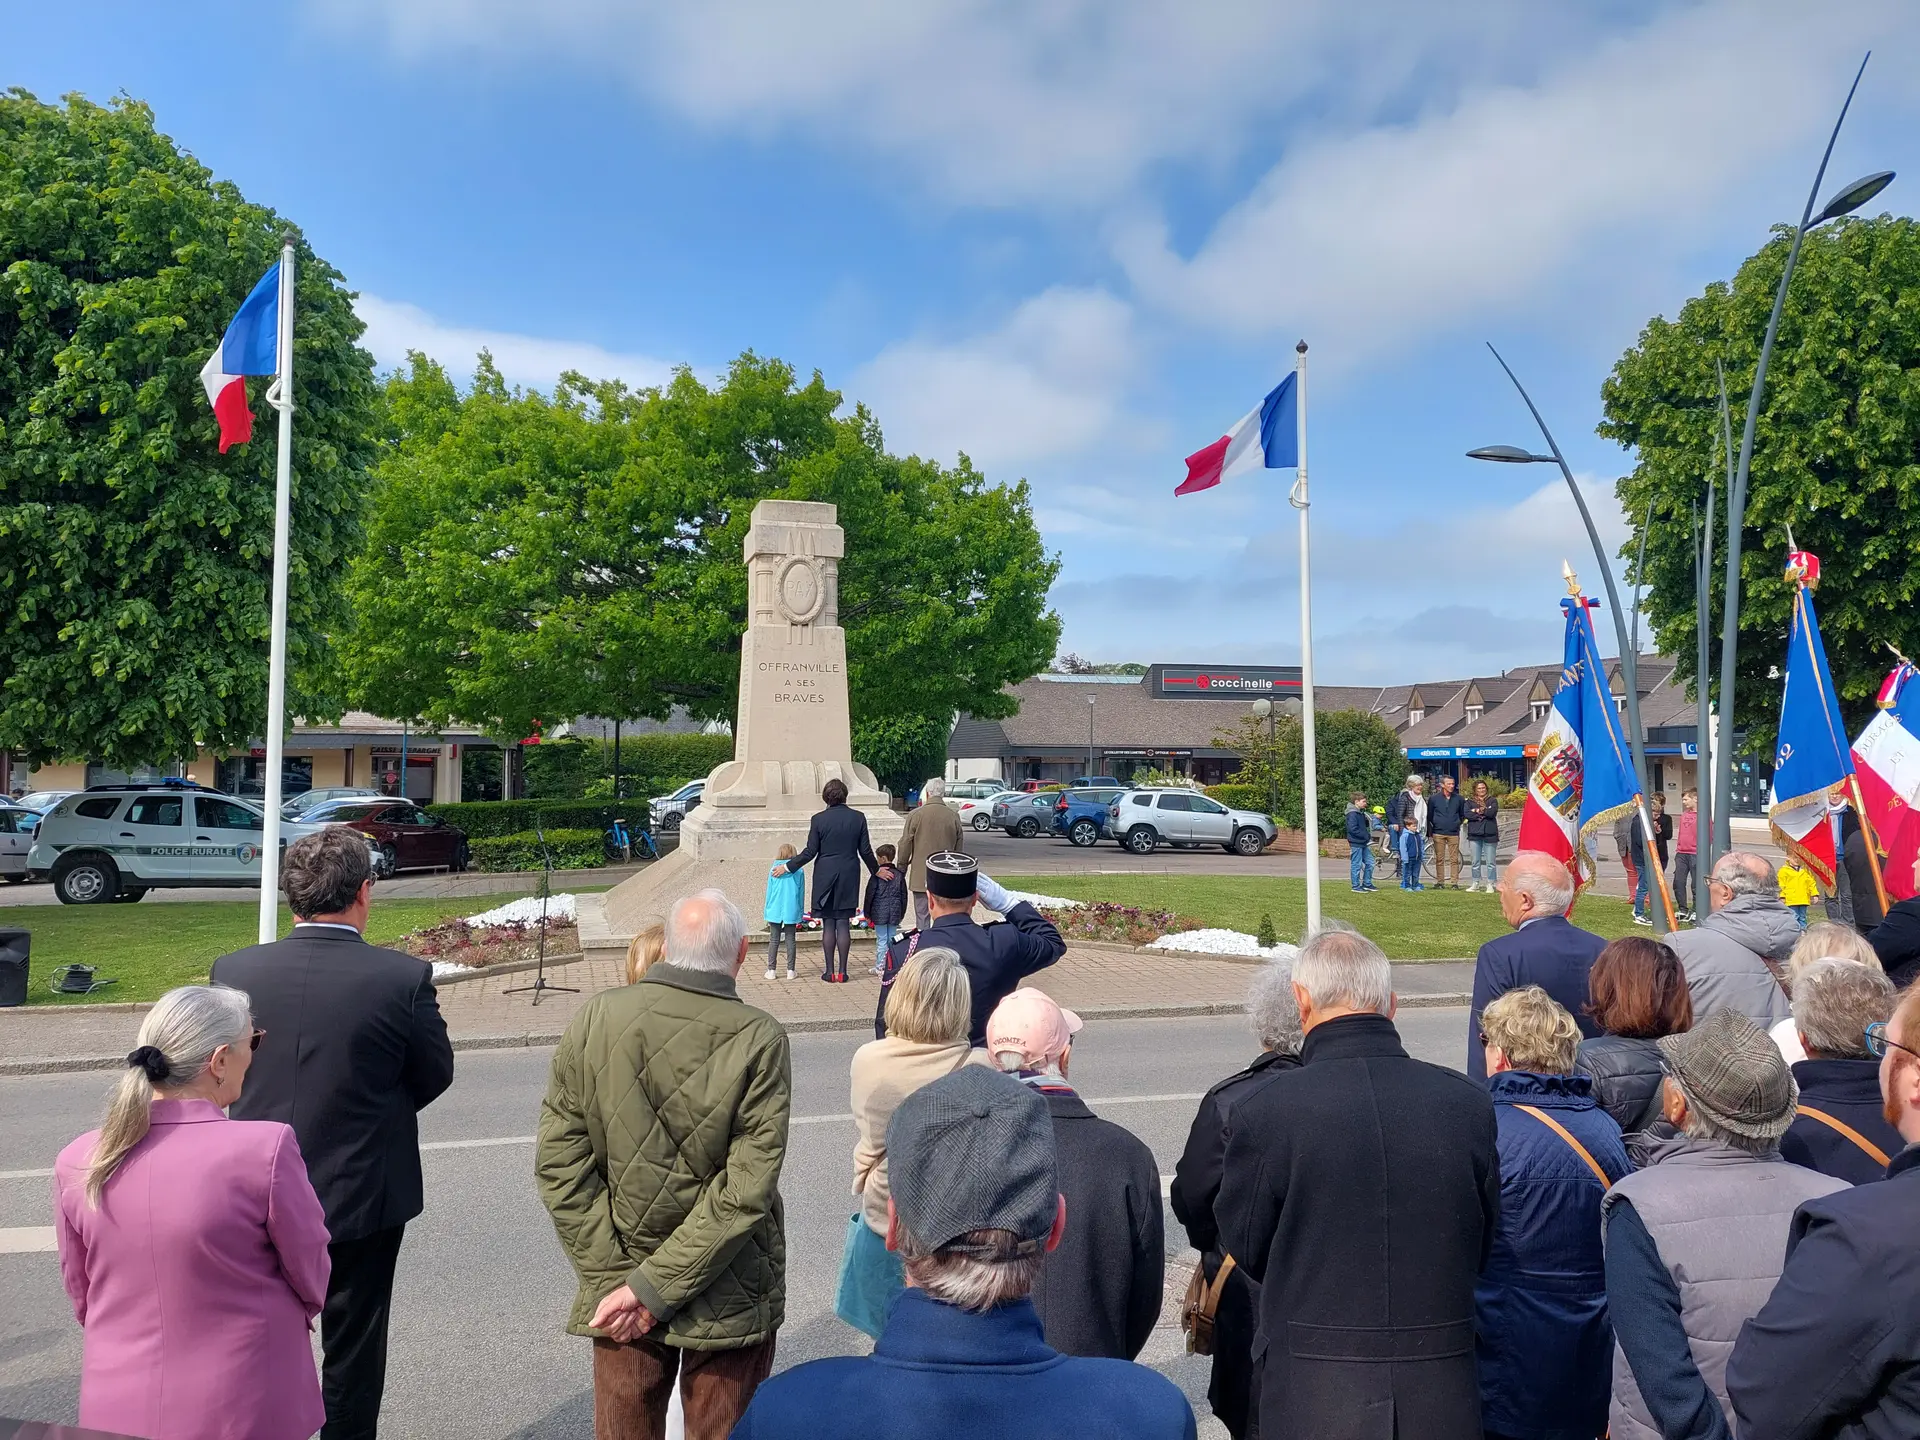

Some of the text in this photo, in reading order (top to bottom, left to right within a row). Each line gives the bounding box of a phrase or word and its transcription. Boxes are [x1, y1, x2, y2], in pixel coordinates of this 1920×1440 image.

[786, 580, 814, 598] PAX
[758, 662, 840, 673] OFFRANVILLE
[784, 679, 816, 687] A SES
[1210, 677, 1273, 688] coccinelle
[774, 693, 825, 703] BRAVES
[150, 847, 188, 855] POLICE
[993, 1036, 1021, 1046] VICOMTE
